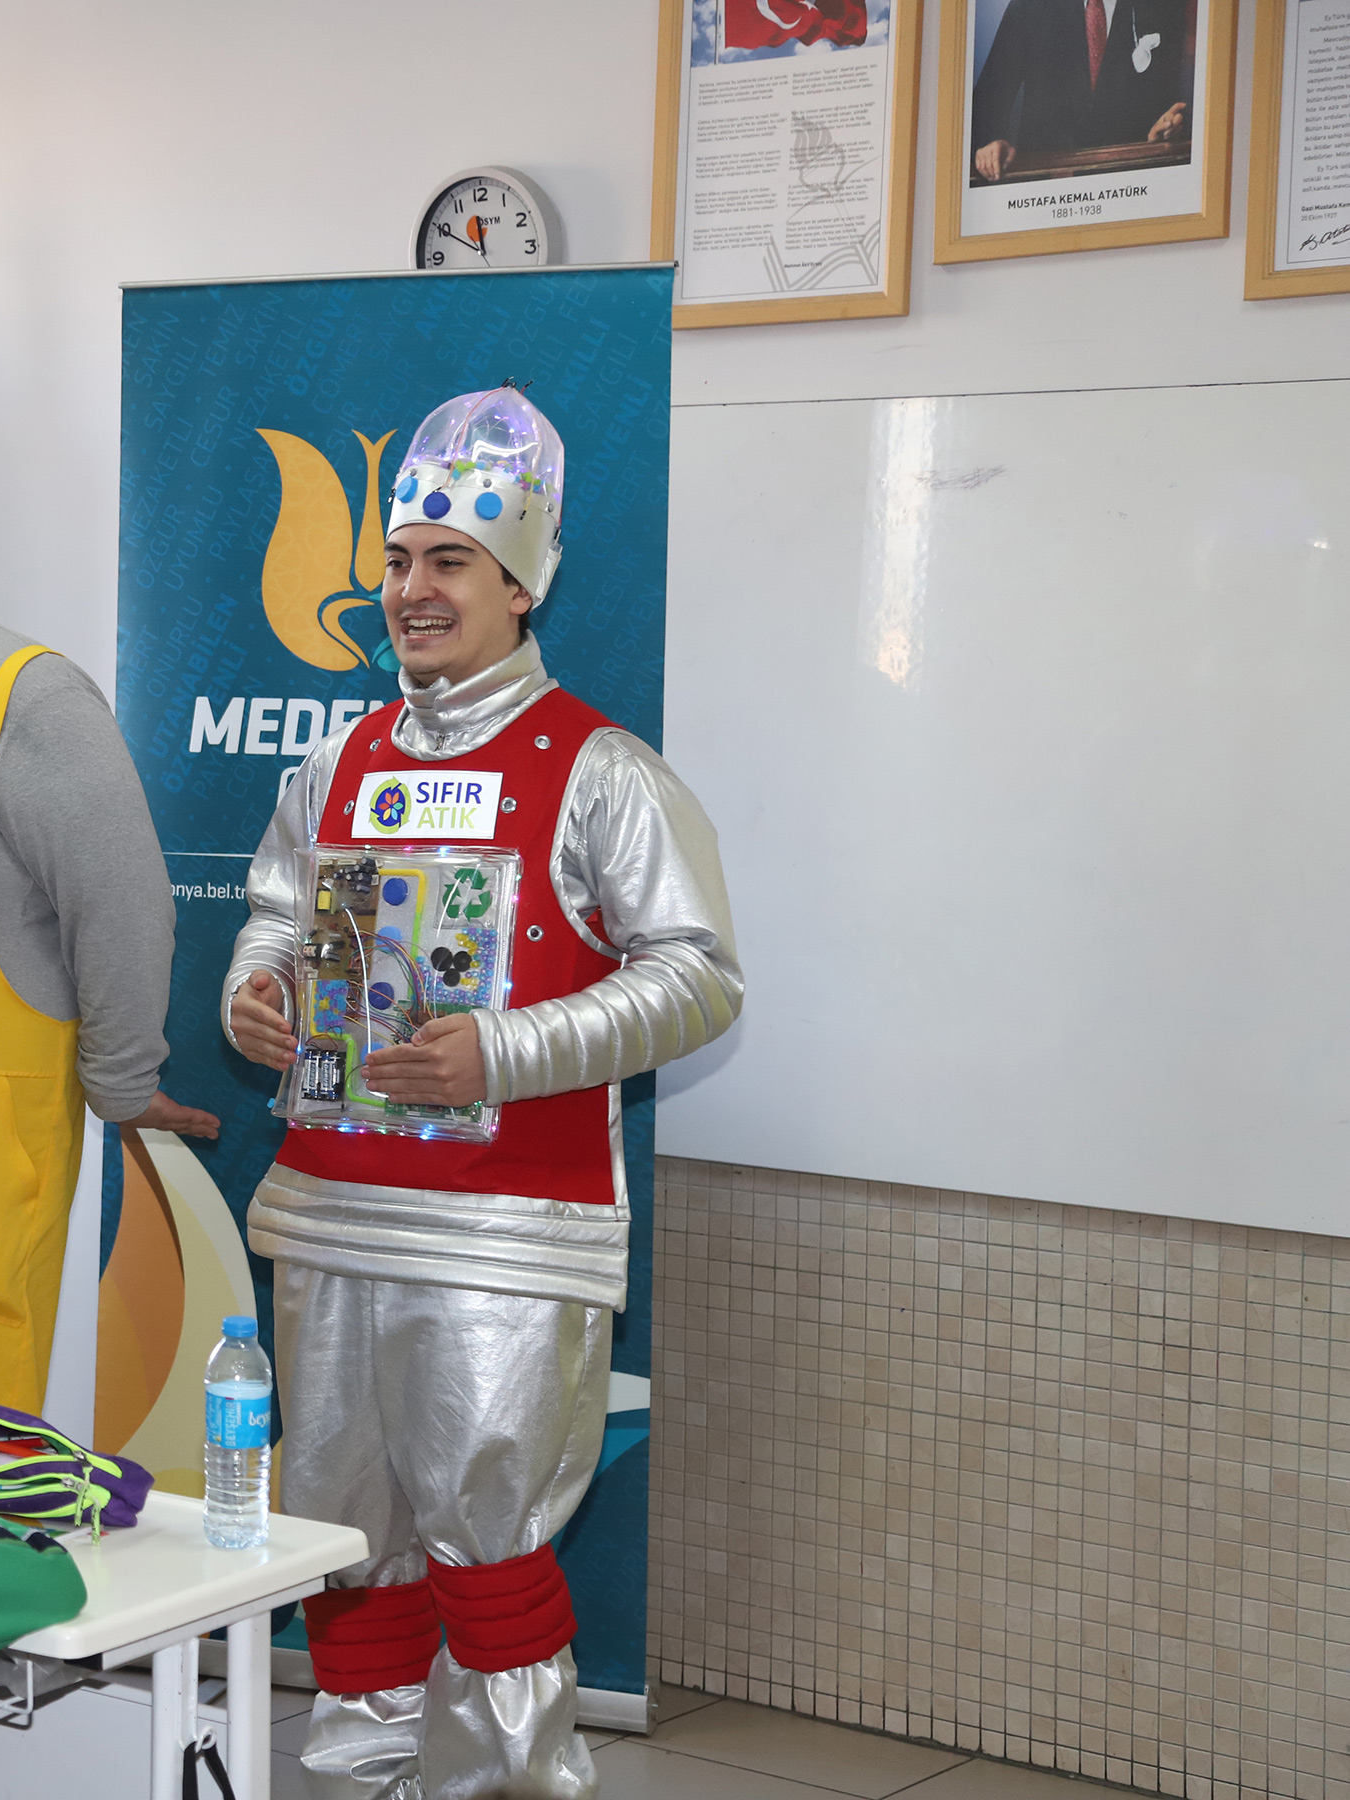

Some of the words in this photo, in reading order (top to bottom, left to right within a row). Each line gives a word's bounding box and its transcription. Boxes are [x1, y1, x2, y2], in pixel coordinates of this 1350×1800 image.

[472, 187, 489, 203] 12
[502, 193, 507, 207] 1
[1008, 195, 1057, 210] MUSTAFA
[1059, 191, 1096, 205] KEMAL
[1097, 185, 1148, 200] ATATÜRK
[454, 198, 464, 214] 11
[1052, 204, 1103, 219] 1881-1938
[515, 212, 528, 228] 2
[436, 222, 452, 238] 10
[524, 239, 538, 255] 3
[432, 251, 445, 266] 9
[416, 781, 483, 804] SIFIR
[417, 807, 477, 829] ATIK
